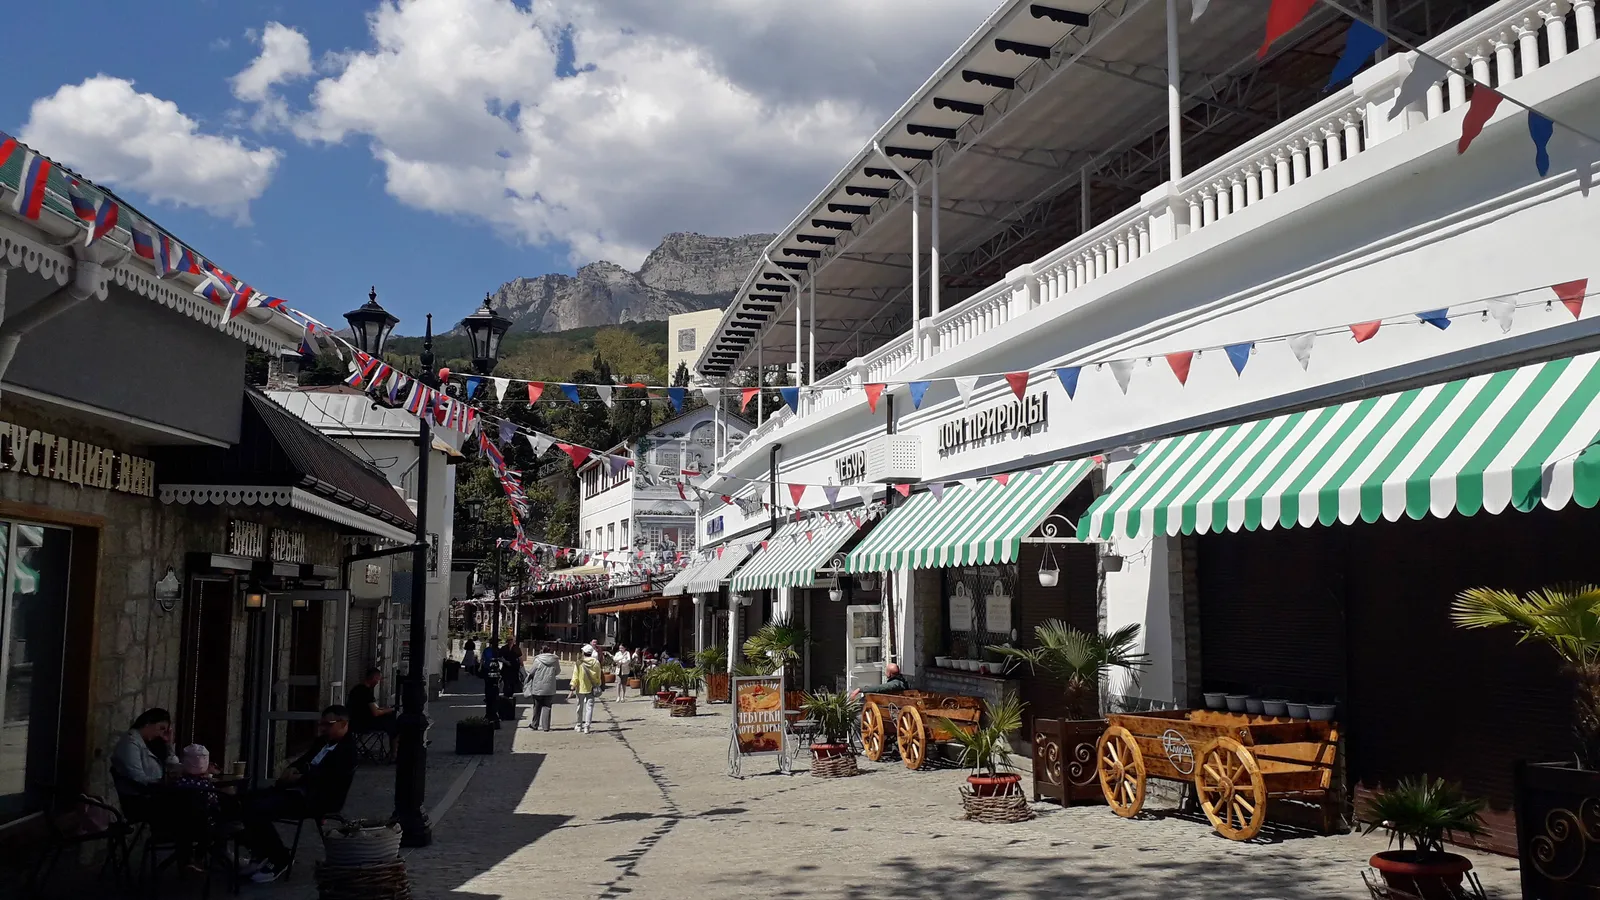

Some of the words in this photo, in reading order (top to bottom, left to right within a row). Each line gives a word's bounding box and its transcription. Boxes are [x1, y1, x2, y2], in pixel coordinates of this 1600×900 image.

[938, 418, 966, 451] ДОМ
[966, 391, 1048, 441] ПРИРОДЫ
[119, 452, 155, 497] ВИН
[835, 450, 868, 481] ЧЕБУР
[233, 520, 263, 557] ВИНА
[272, 528, 305, 563] КРЫМА
[738, 711, 781, 724] ЧЕБУРЕКИ
